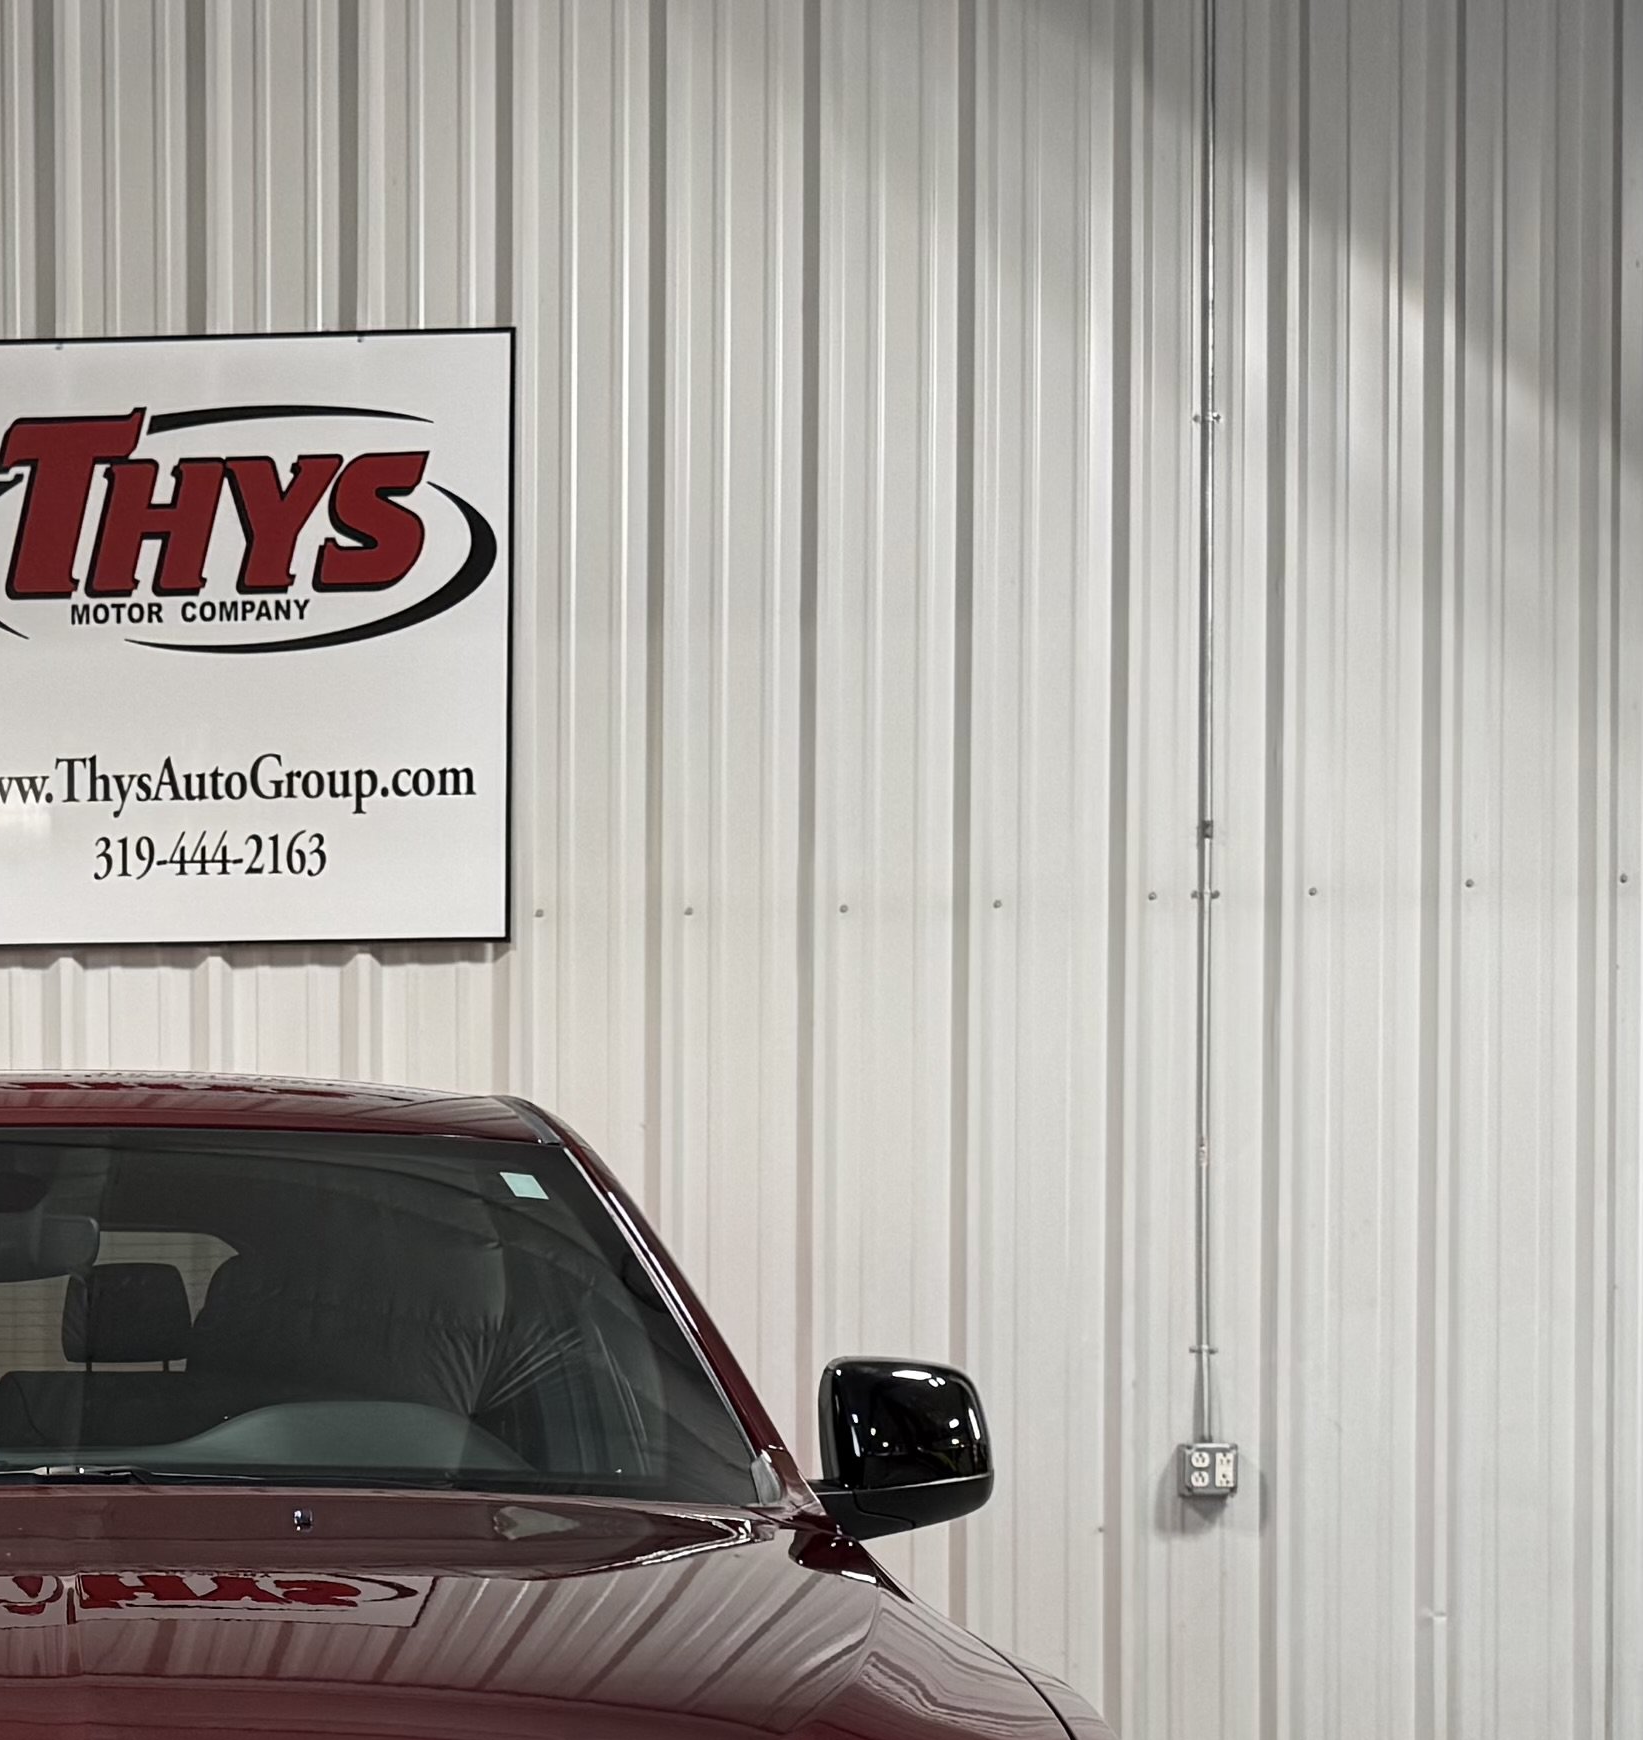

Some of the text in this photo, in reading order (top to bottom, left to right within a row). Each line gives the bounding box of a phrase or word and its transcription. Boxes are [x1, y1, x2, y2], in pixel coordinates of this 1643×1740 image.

[70, 599, 311, 626] MOTOR COMPANY
[93, 829, 328, 881] 319-444-2163
